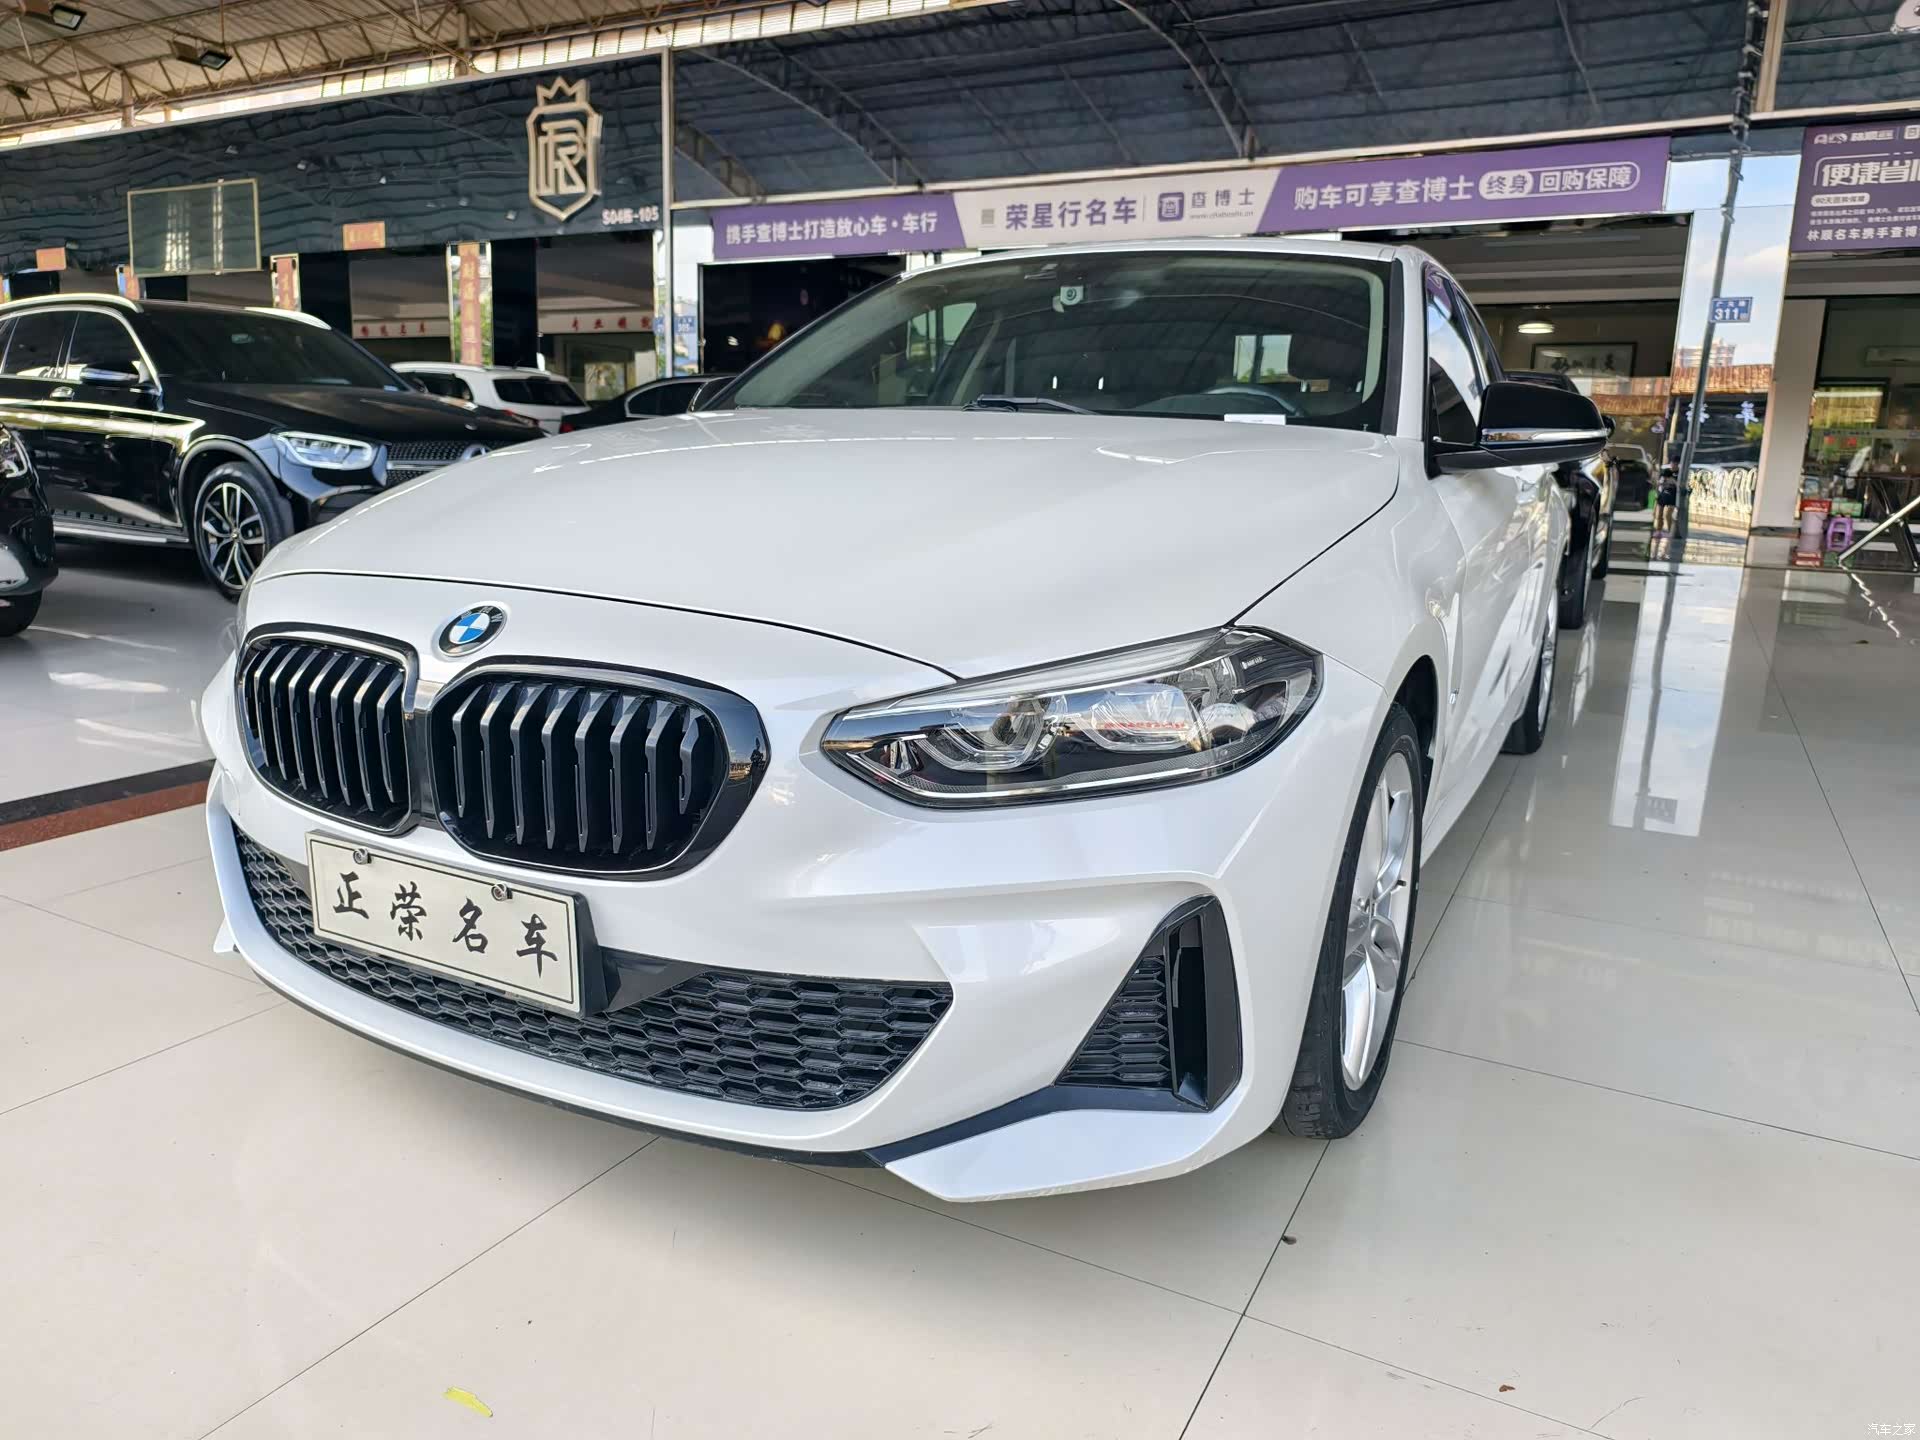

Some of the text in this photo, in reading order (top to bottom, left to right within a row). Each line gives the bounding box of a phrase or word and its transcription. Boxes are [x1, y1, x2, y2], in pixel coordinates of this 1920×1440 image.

[1293, 166, 1632, 210] 购车可享查博士 终身 回购保障
[1005, 197, 1137, 231] 荣星行名车
[332, 870, 559, 979] 正荣名车
